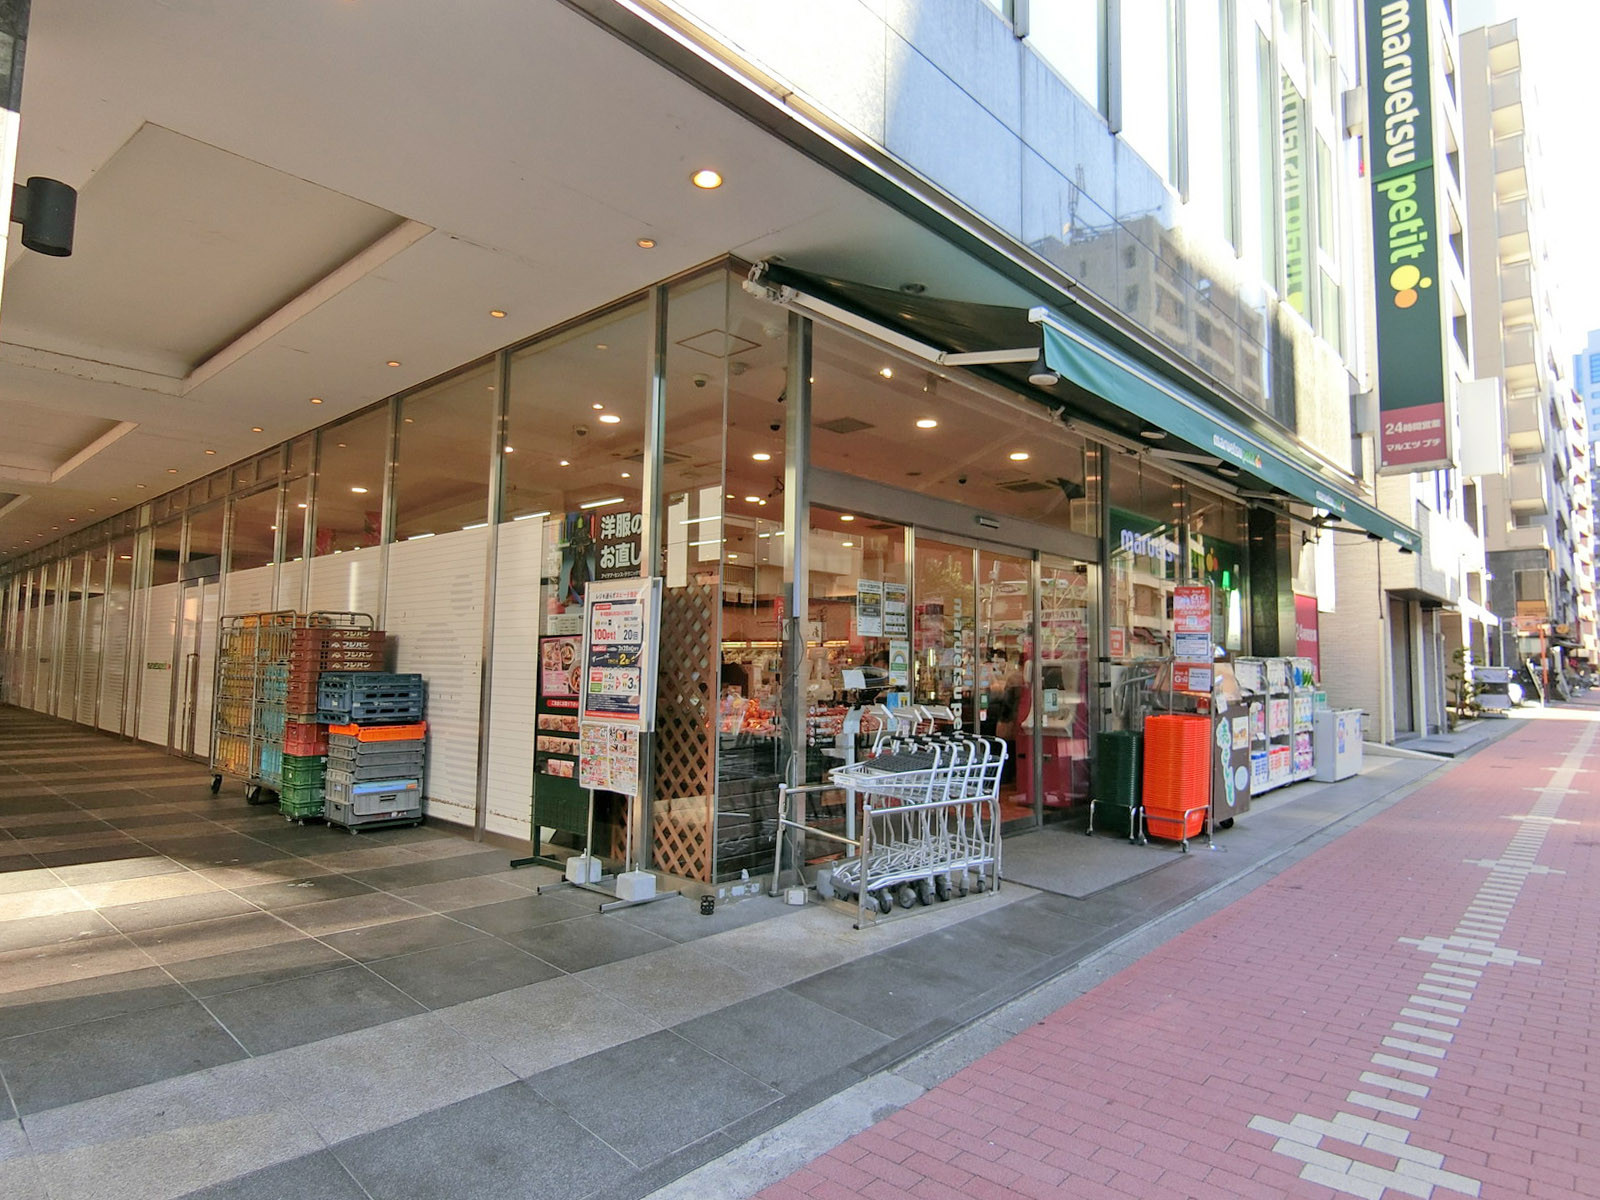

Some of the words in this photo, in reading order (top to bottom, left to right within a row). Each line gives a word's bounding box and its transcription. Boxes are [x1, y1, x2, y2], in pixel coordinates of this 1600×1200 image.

[1381, 0, 1420, 168] maruetsu
[1377, 173, 1428, 264] petit
[600, 512, 642, 540] 洋服の
[600, 542, 642, 568] お直し
